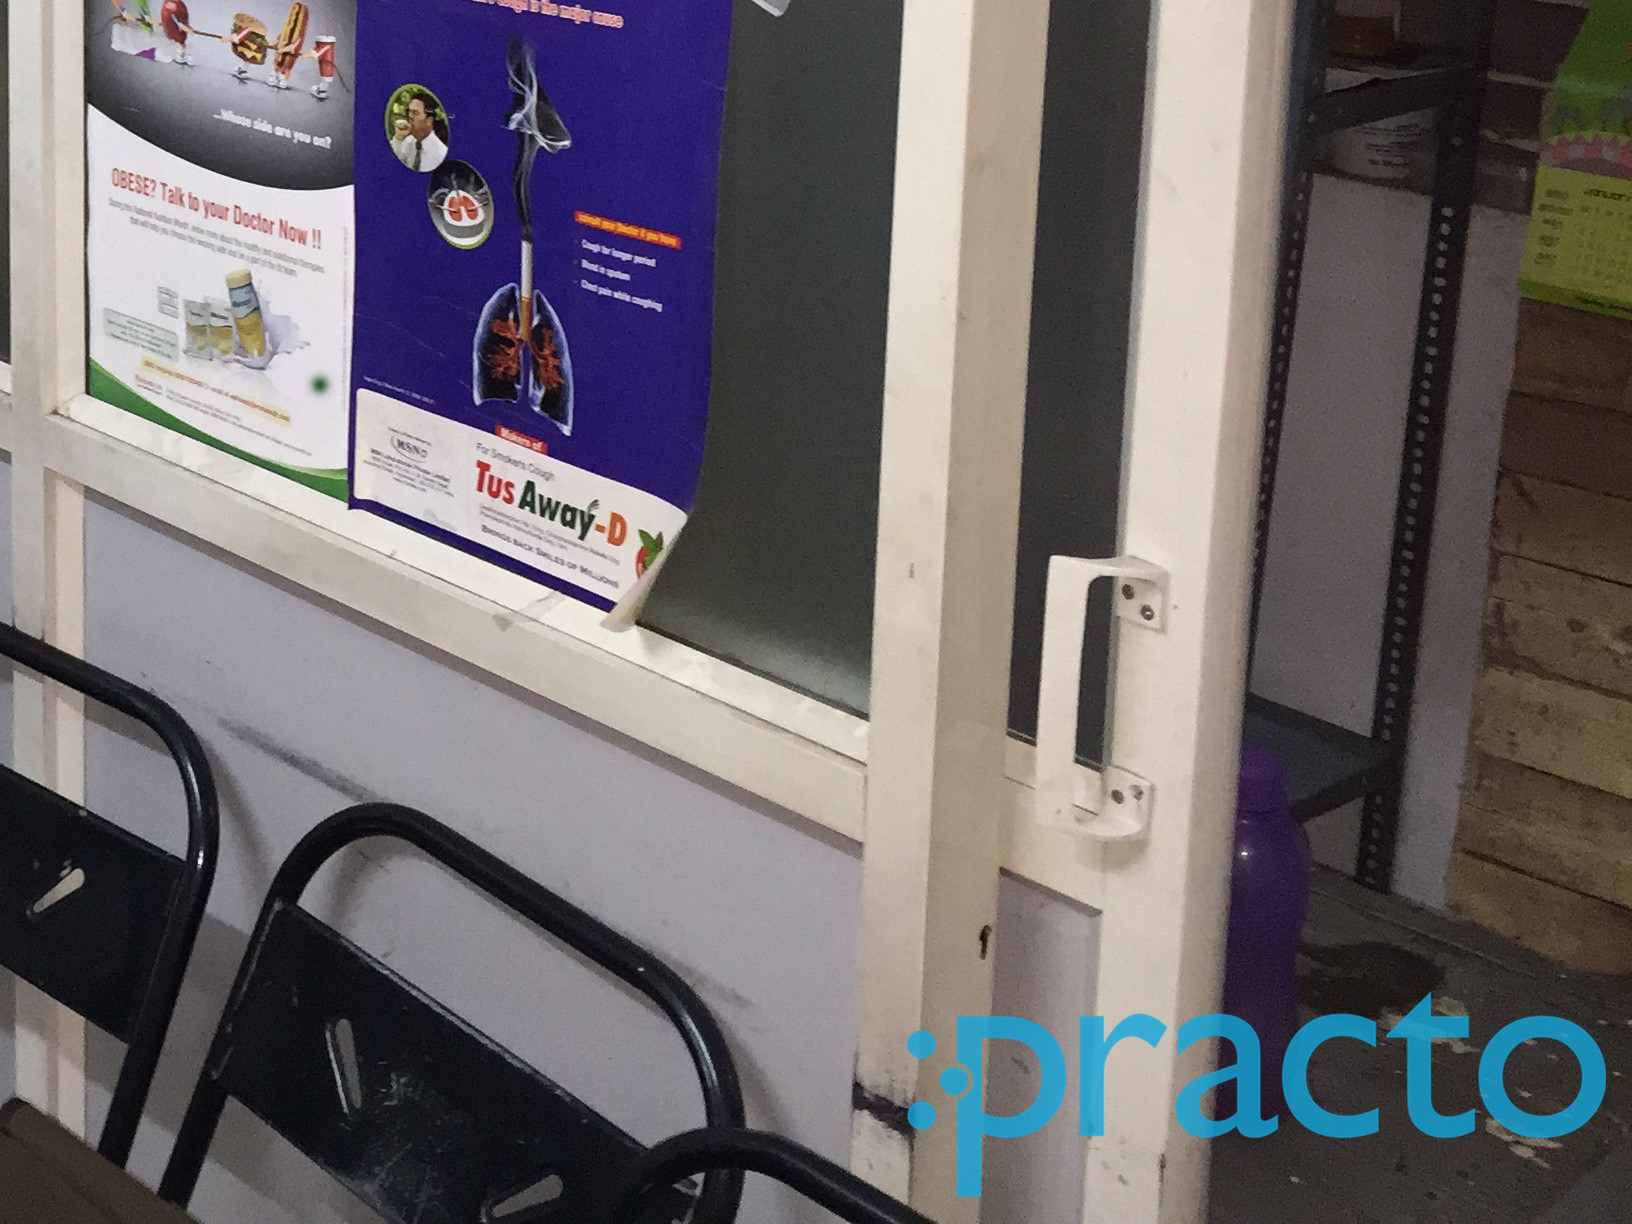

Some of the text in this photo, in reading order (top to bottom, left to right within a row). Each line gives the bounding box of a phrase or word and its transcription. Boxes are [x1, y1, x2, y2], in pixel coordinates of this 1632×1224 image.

[560, 2, 592, 25] major
[111, 167, 157, 197] OBESE?
[160, 181, 185, 207] Talk
[188, 190, 200, 211] to
[202, 197, 230, 221] your
[233, 203, 275, 236] Doctor
[278, 218, 308, 247] Now
[476, 460, 515, 505] Tus
[518, 479, 628, 547] Away-D
